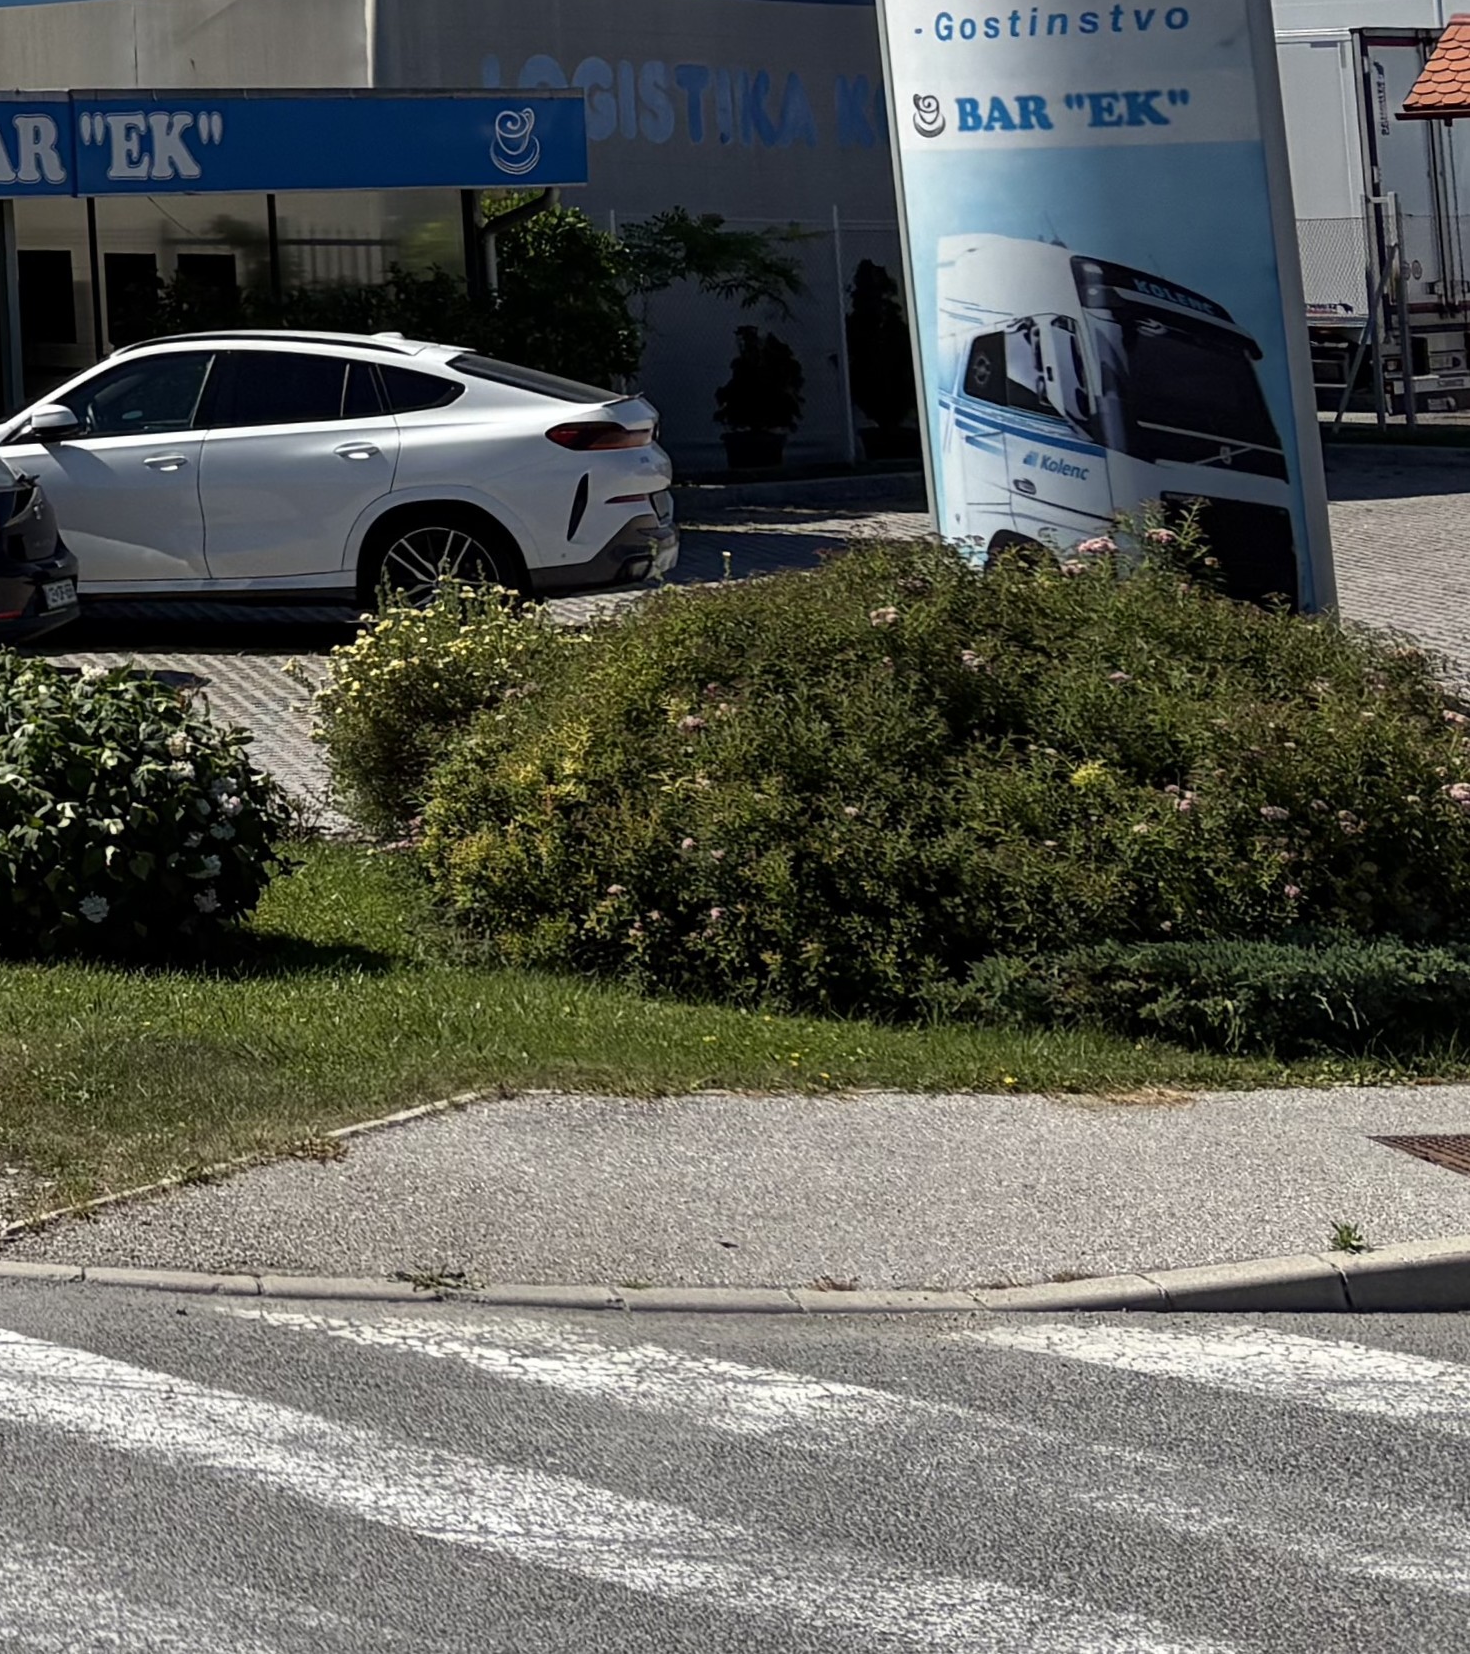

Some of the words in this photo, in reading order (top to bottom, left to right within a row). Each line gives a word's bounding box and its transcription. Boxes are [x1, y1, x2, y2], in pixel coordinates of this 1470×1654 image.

[935, 3, 1190, 42] Gostinstvo
[955, 94, 1054, 133] BAR
[1065, 89, 1190, 129] "EK"
[79, 111, 223, 181] "EK"
[1040, 455, 1089, 481] Kolenc
